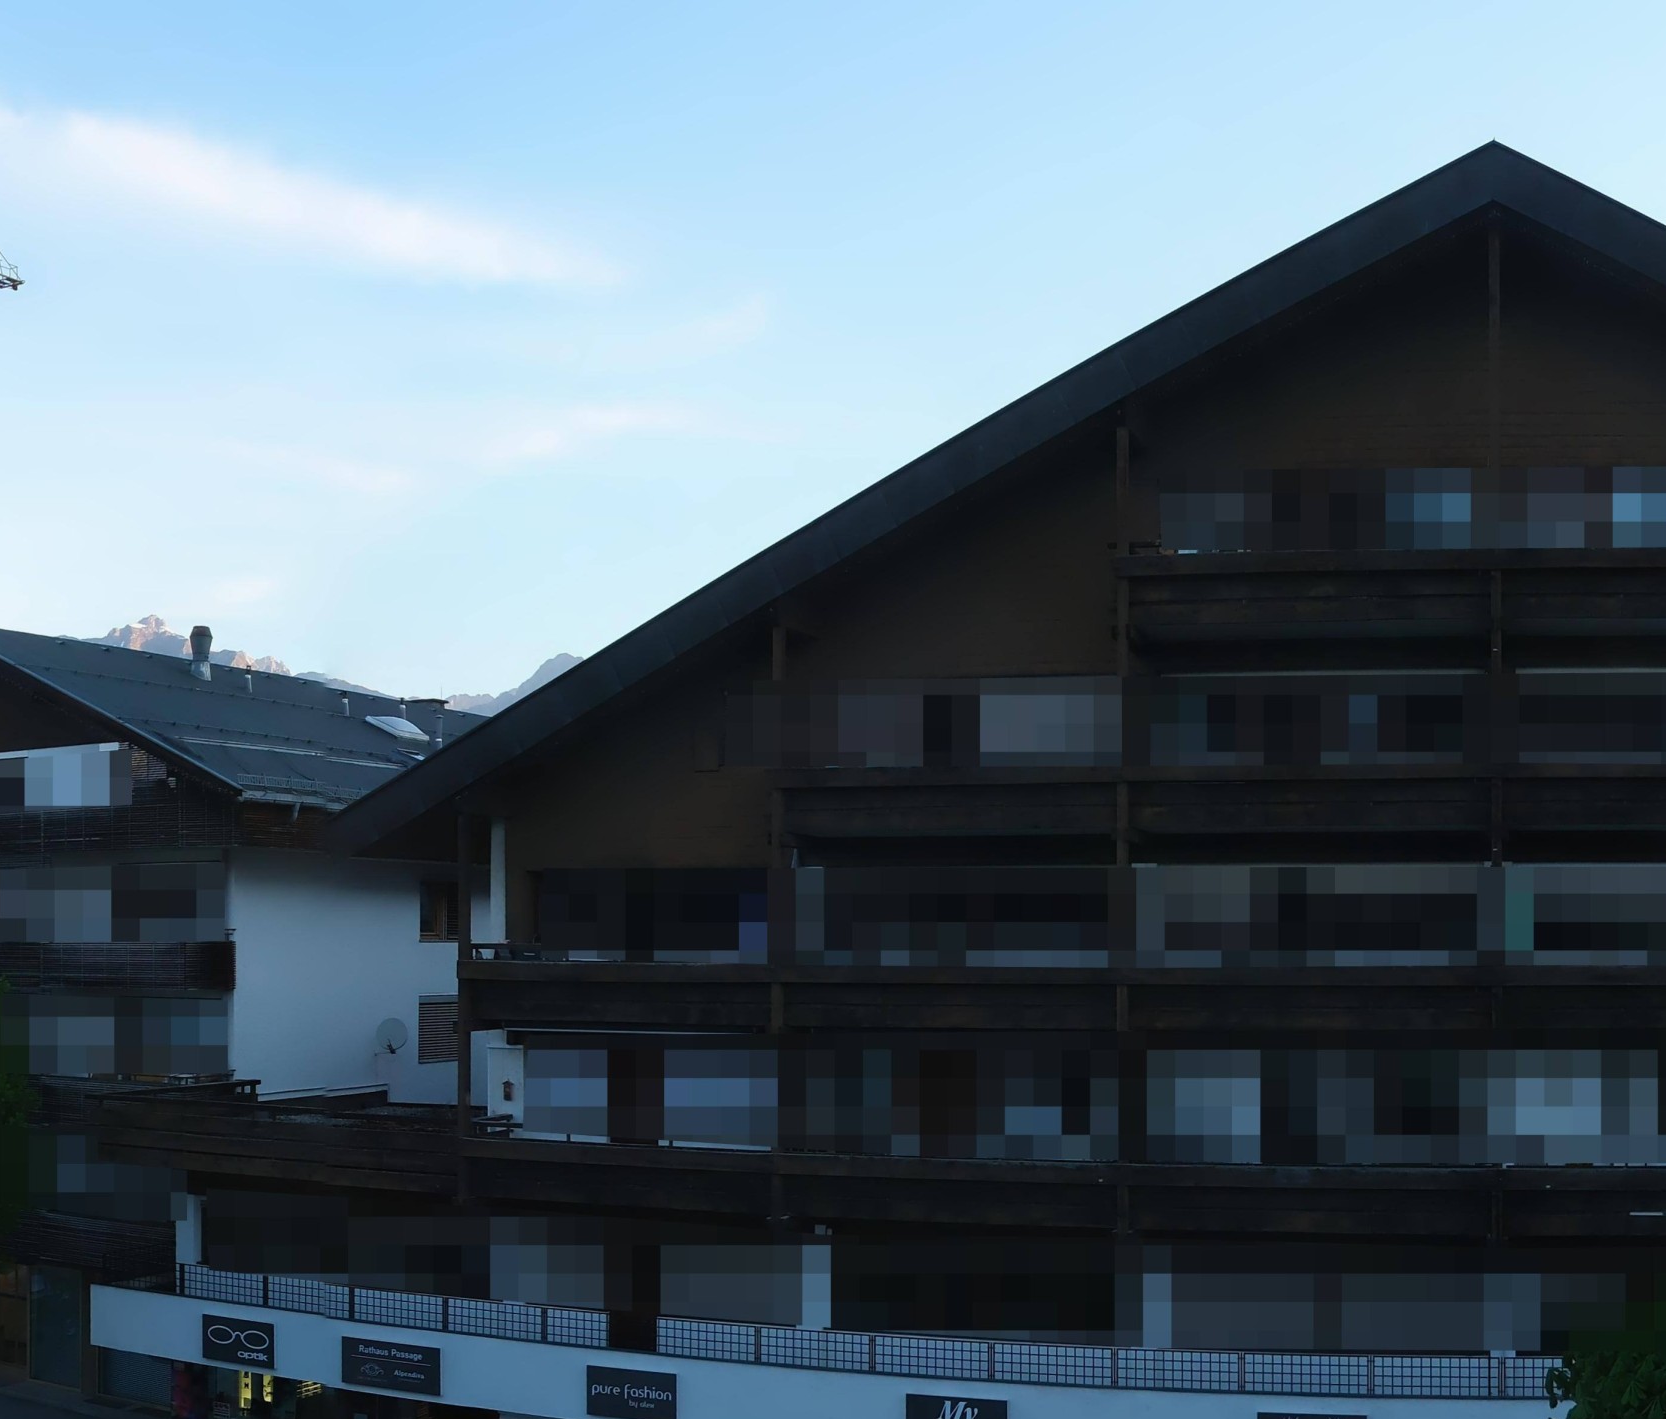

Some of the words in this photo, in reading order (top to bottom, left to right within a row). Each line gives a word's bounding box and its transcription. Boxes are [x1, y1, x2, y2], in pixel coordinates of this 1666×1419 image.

[237, 1350, 269, 1361] optik
[358, 1344, 388, 1356] Rathaus
[391, 1348, 422, 1361] Passage
[591, 1384, 620, 1396] pure
[624, 1383, 672, 1400] fashion
[628, 1400, 638, 1408] by
